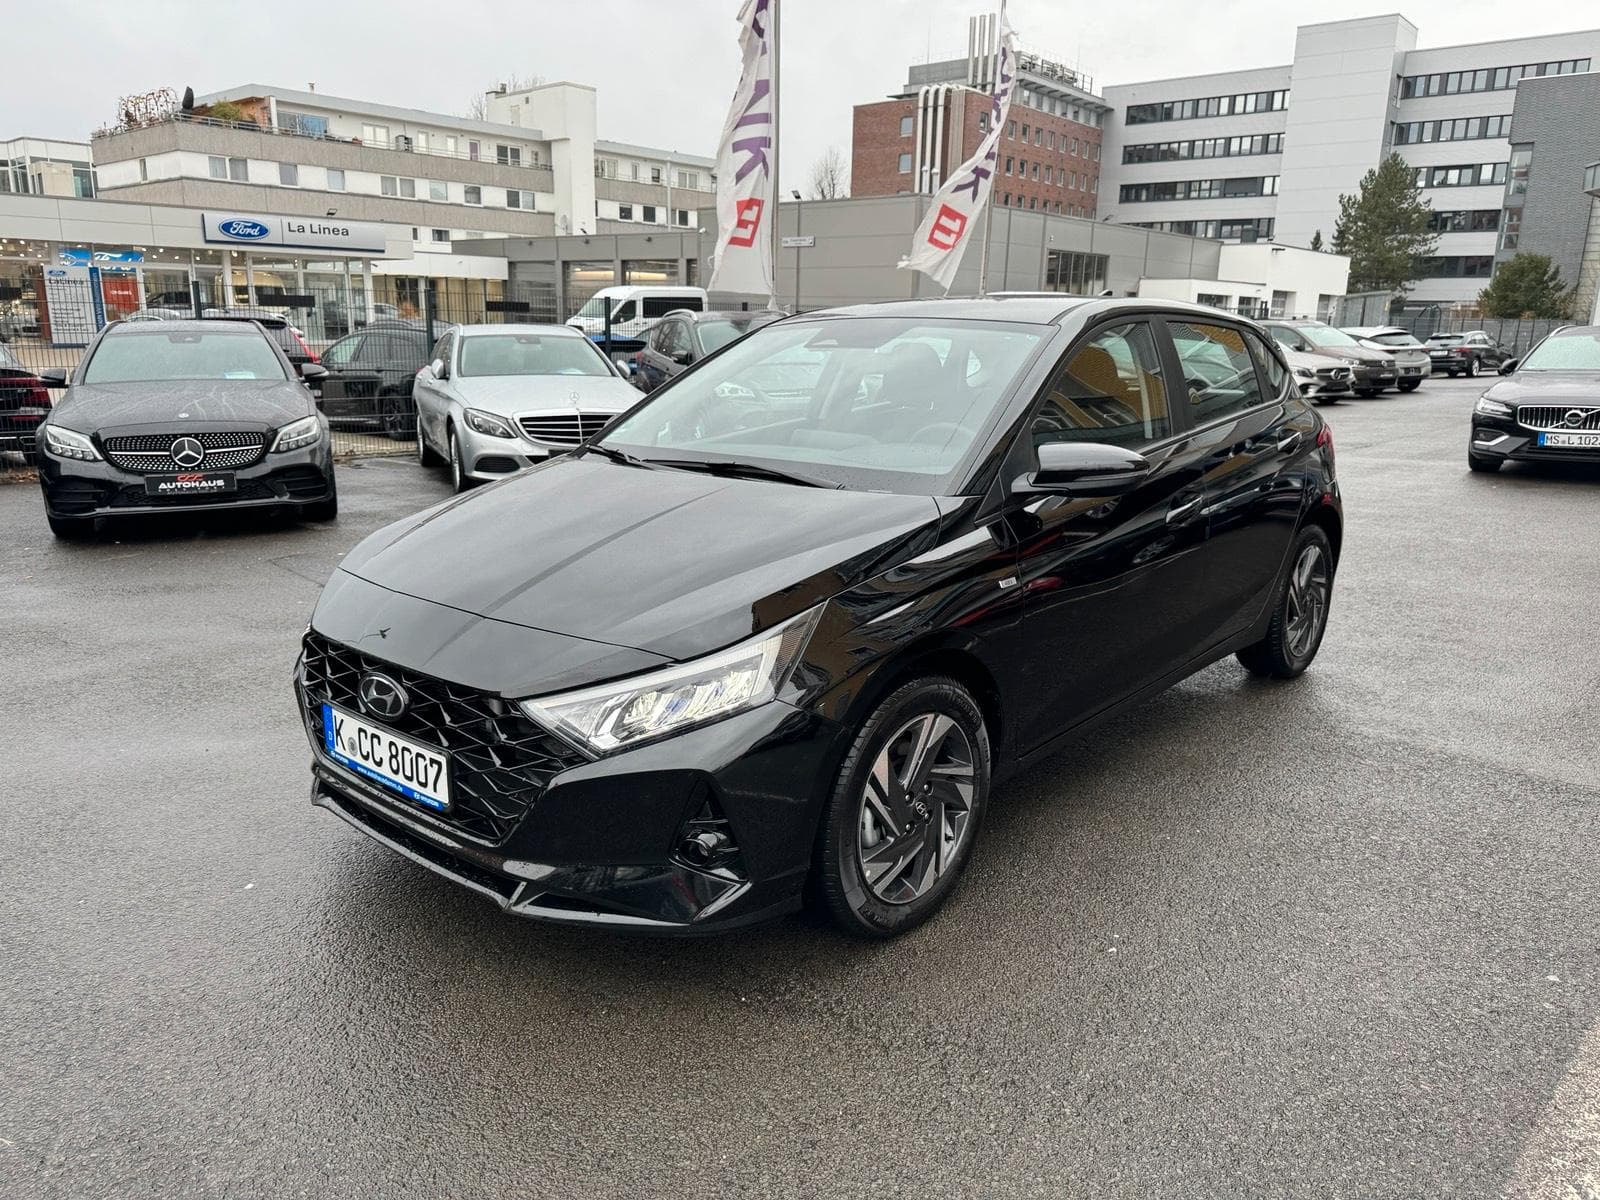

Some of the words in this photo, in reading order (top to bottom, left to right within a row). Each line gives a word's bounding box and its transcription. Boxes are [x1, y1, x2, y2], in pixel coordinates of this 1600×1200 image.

[287, 222, 305, 233] La
[310, 224, 349, 236] Linea
[933, 214, 961, 246] 11
[1545, 436, 1560, 445] MS
[1567, 436, 1574, 445] L
[158, 480, 224, 489] AUTOHAUS
[334, 714, 346, 752] K
[358, 727, 383, 767] CC
[389, 741, 442, 793] 8007
